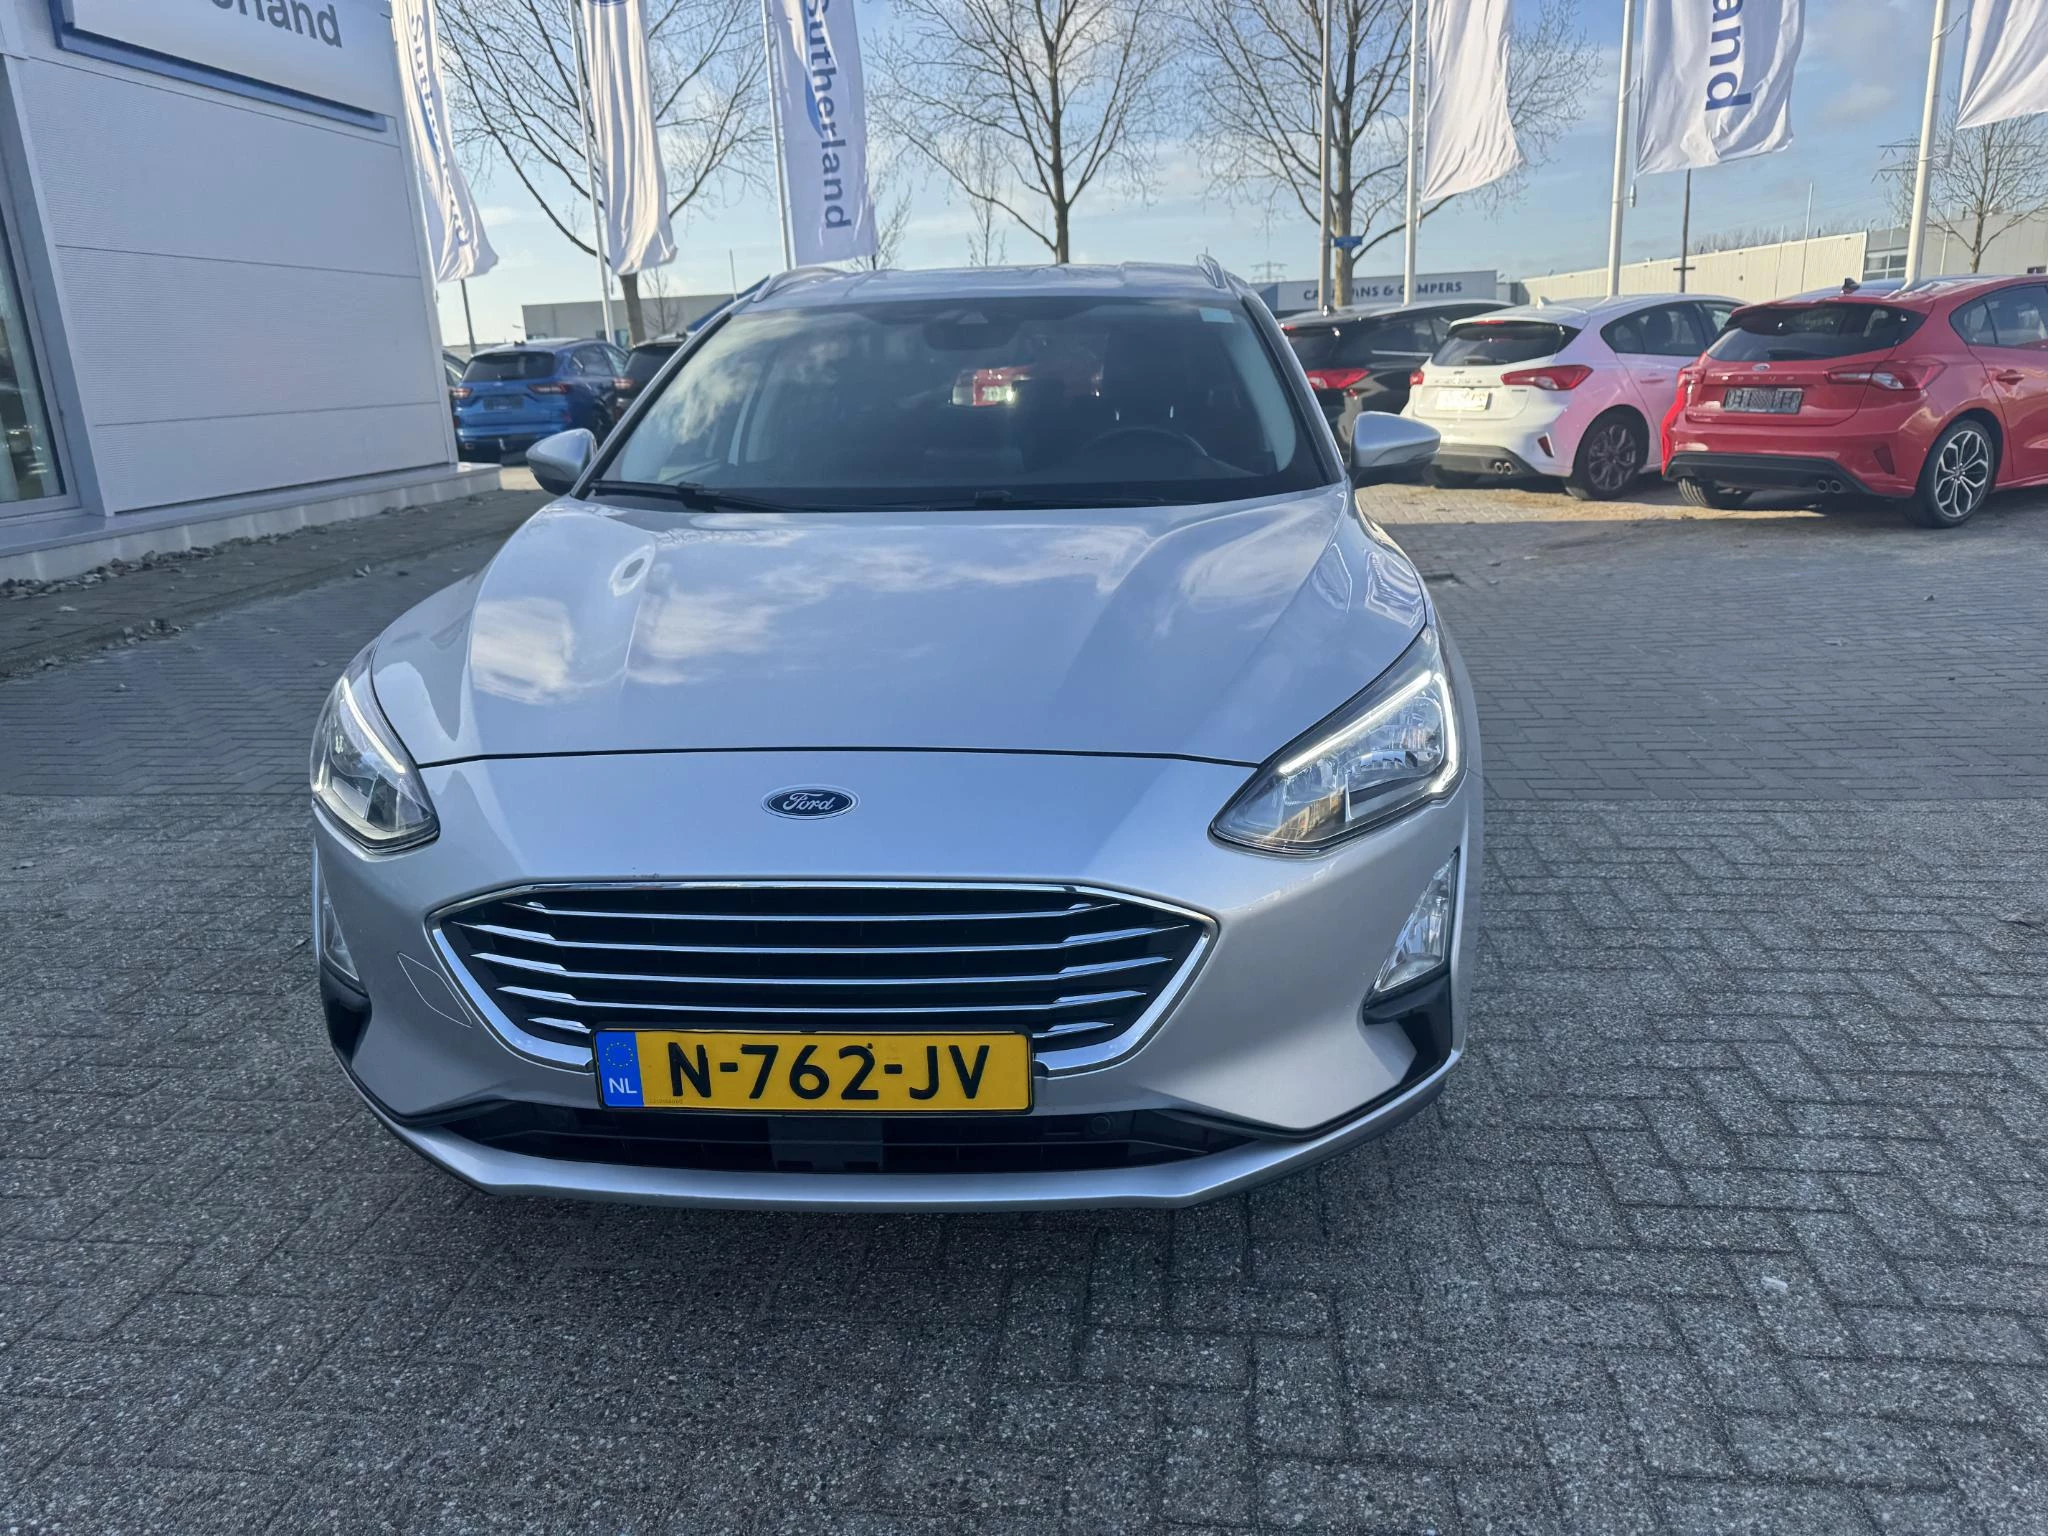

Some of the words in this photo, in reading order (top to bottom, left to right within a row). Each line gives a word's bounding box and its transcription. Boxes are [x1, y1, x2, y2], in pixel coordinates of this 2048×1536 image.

[211, 0, 343, 48] and
[1303, 285, 1379, 301] CAANS
[1383, 284, 1395, 297] &
[1398, 281, 1462, 296] CMPERS
[782, 792, 836, 811] Ford
[667, 1041, 990, 1101] N-762-JV
[608, 1077, 638, 1094] NL
